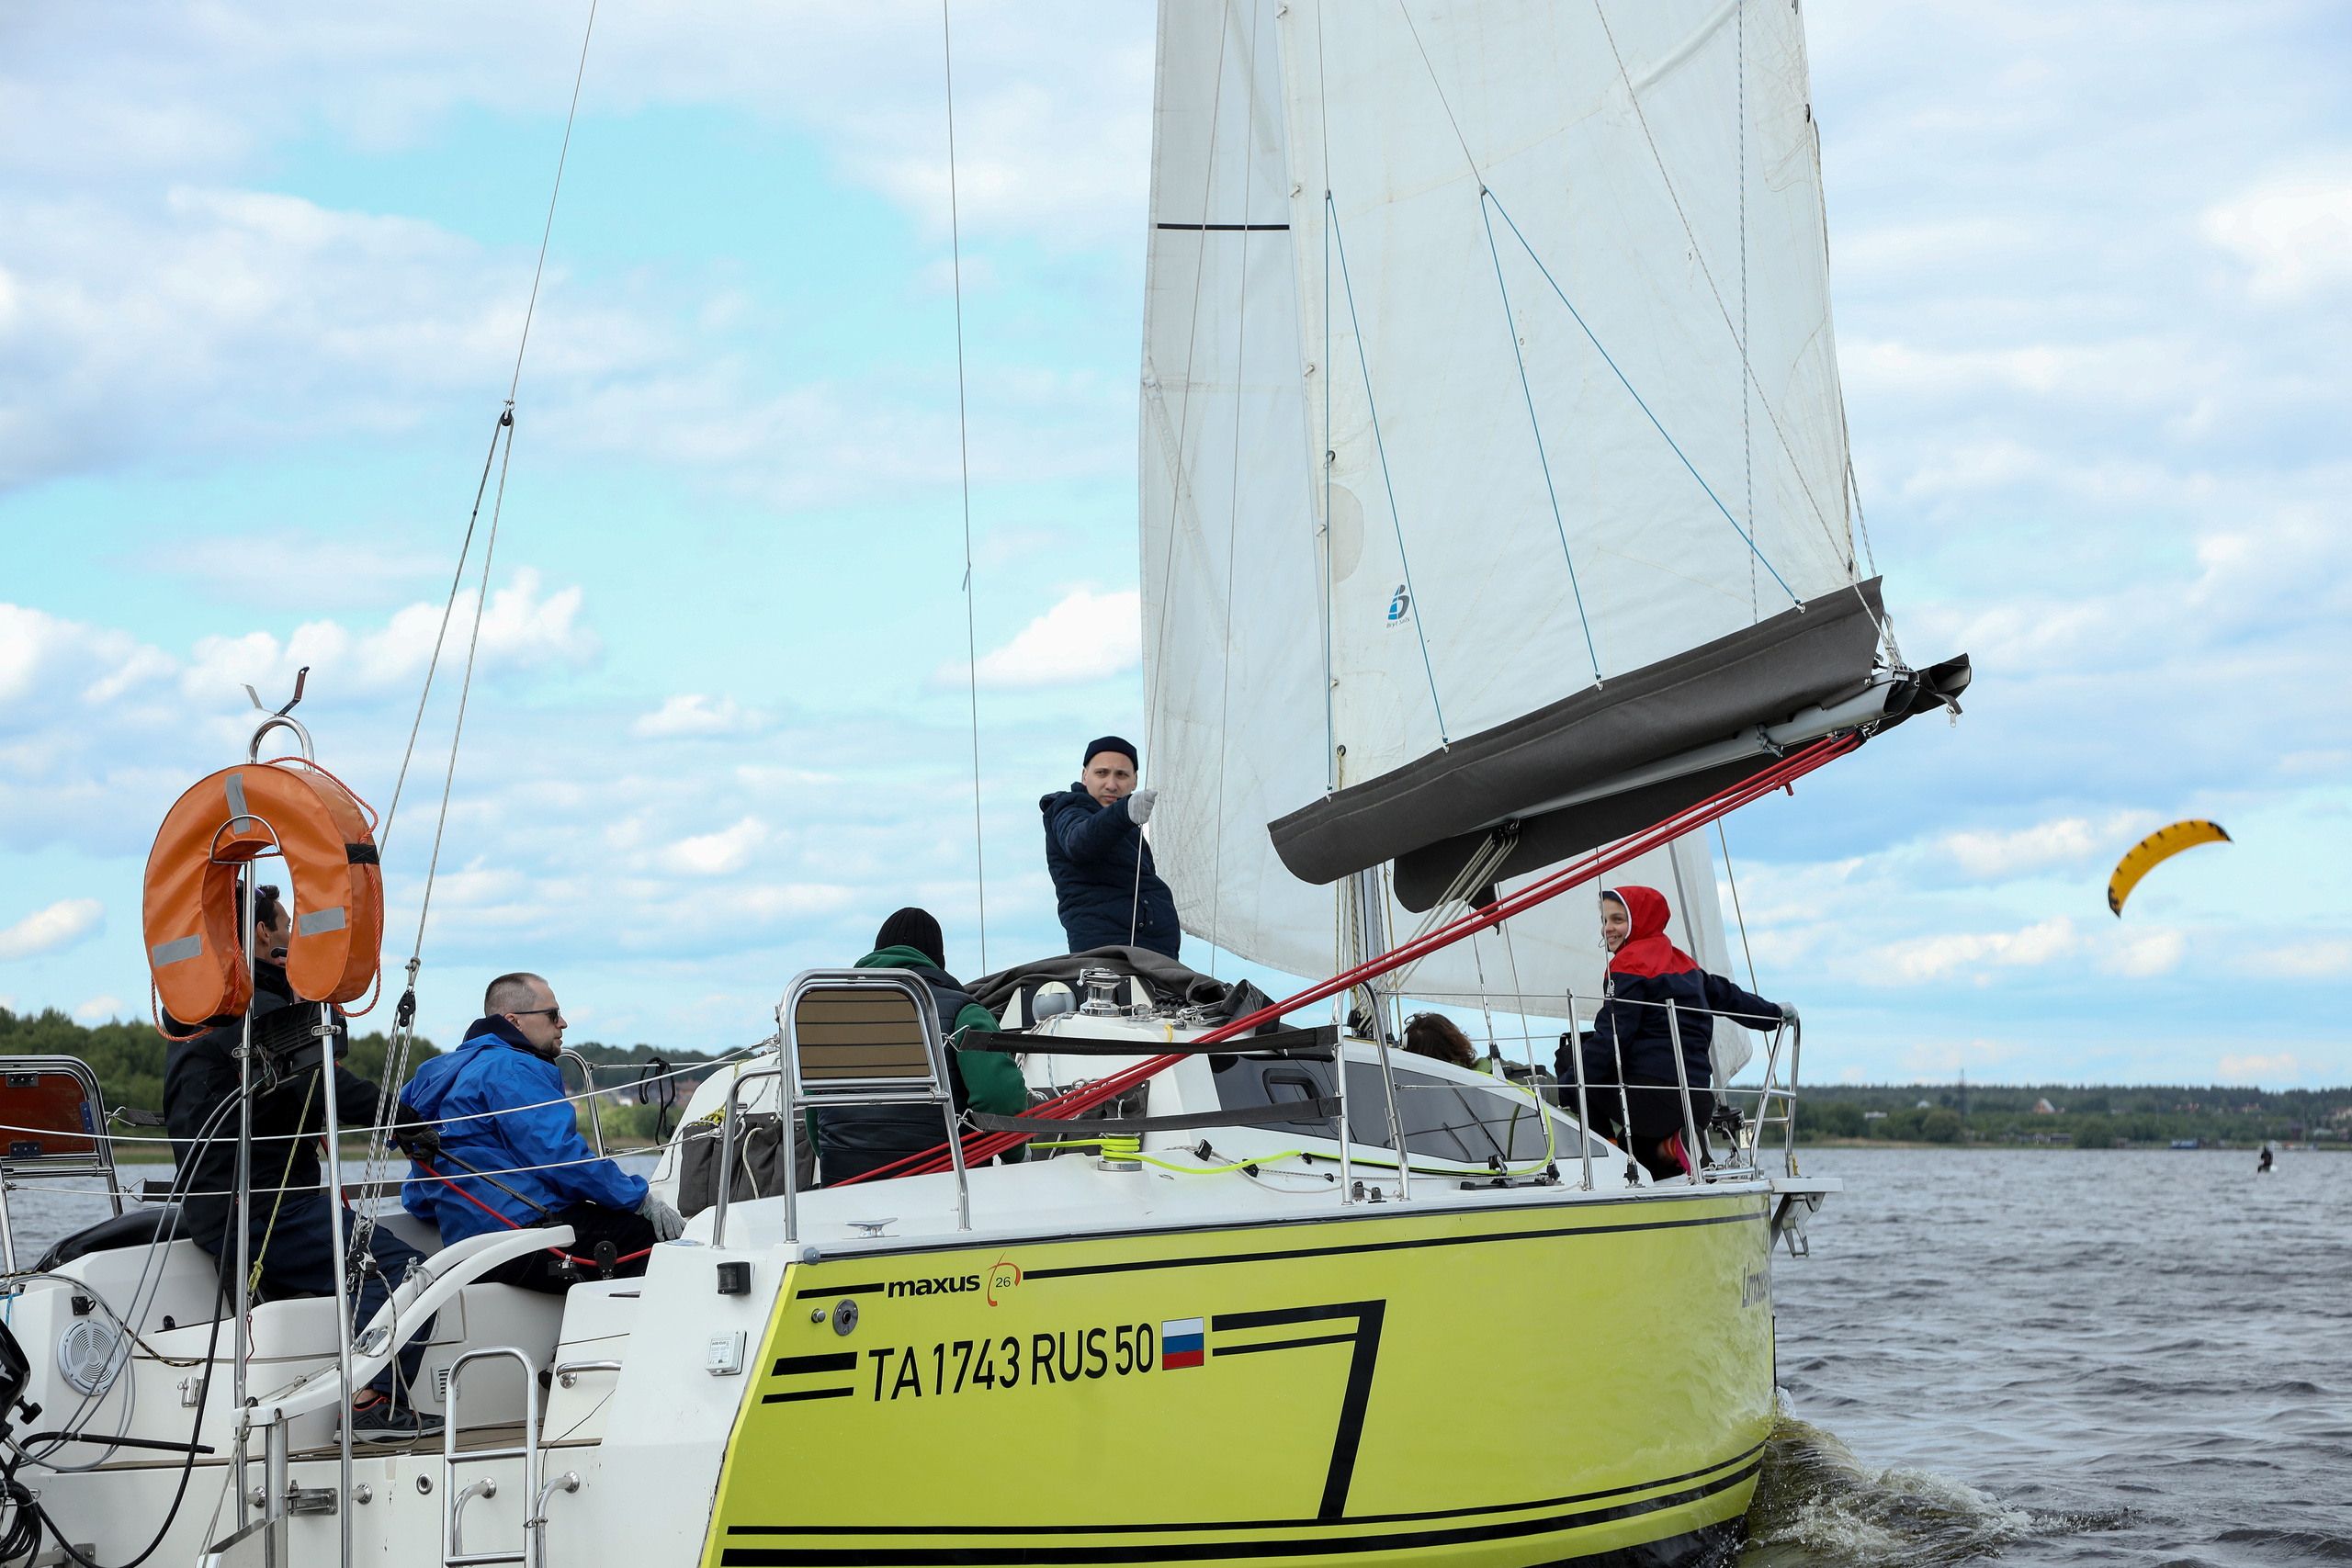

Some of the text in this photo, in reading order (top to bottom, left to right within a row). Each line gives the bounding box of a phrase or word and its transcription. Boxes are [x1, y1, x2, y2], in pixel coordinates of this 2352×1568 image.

[888, 1275, 1011, 1298] maxus 26
[868, 1323, 1154, 1402] TA 1743 RUS 50
